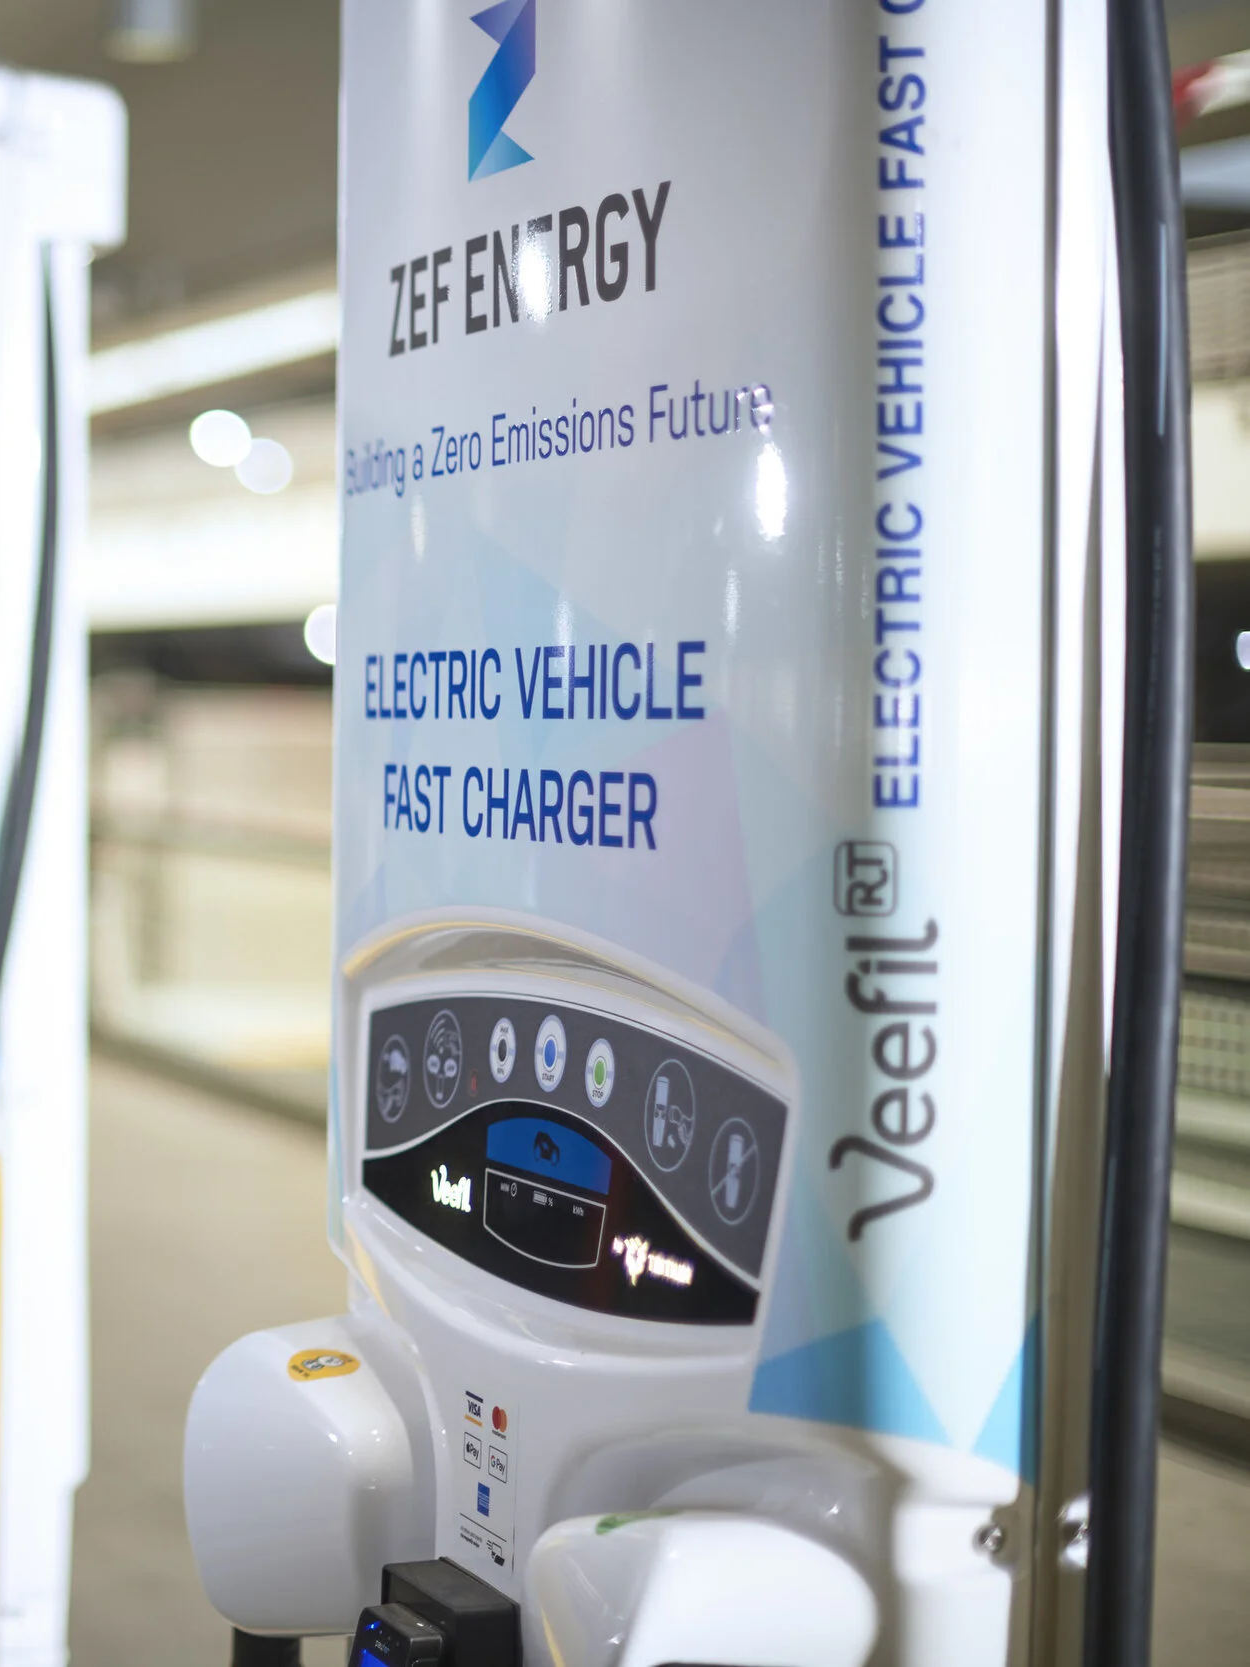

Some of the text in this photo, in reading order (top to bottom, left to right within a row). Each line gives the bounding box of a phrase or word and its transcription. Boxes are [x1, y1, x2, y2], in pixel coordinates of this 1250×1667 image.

[878, 35, 927, 190] FAST
[388, 246, 453, 358] ZEF
[876, 212, 925, 482] VEHICLE
[412, 443, 424, 481] a
[431, 426, 482, 478] Zero
[492, 398, 635, 467] Emissions
[649, 379, 772, 443] Future
[364, 641, 706, 720] ELECTRIC VEHICLE
[872, 502, 924, 809] ELECTRIC
[383, 763, 658, 851] FAST CHARGER
[845, 843, 888, 907] RT
[542, 1073, 555, 1082] START
[591, 1089, 604, 1099] STOP
[828, 917, 939, 1243] Veefil
[468, 1401, 481, 1418] VISA
[470, 1443, 479, 1461] Pay
[496, 1460, 505, 1476] Pay
